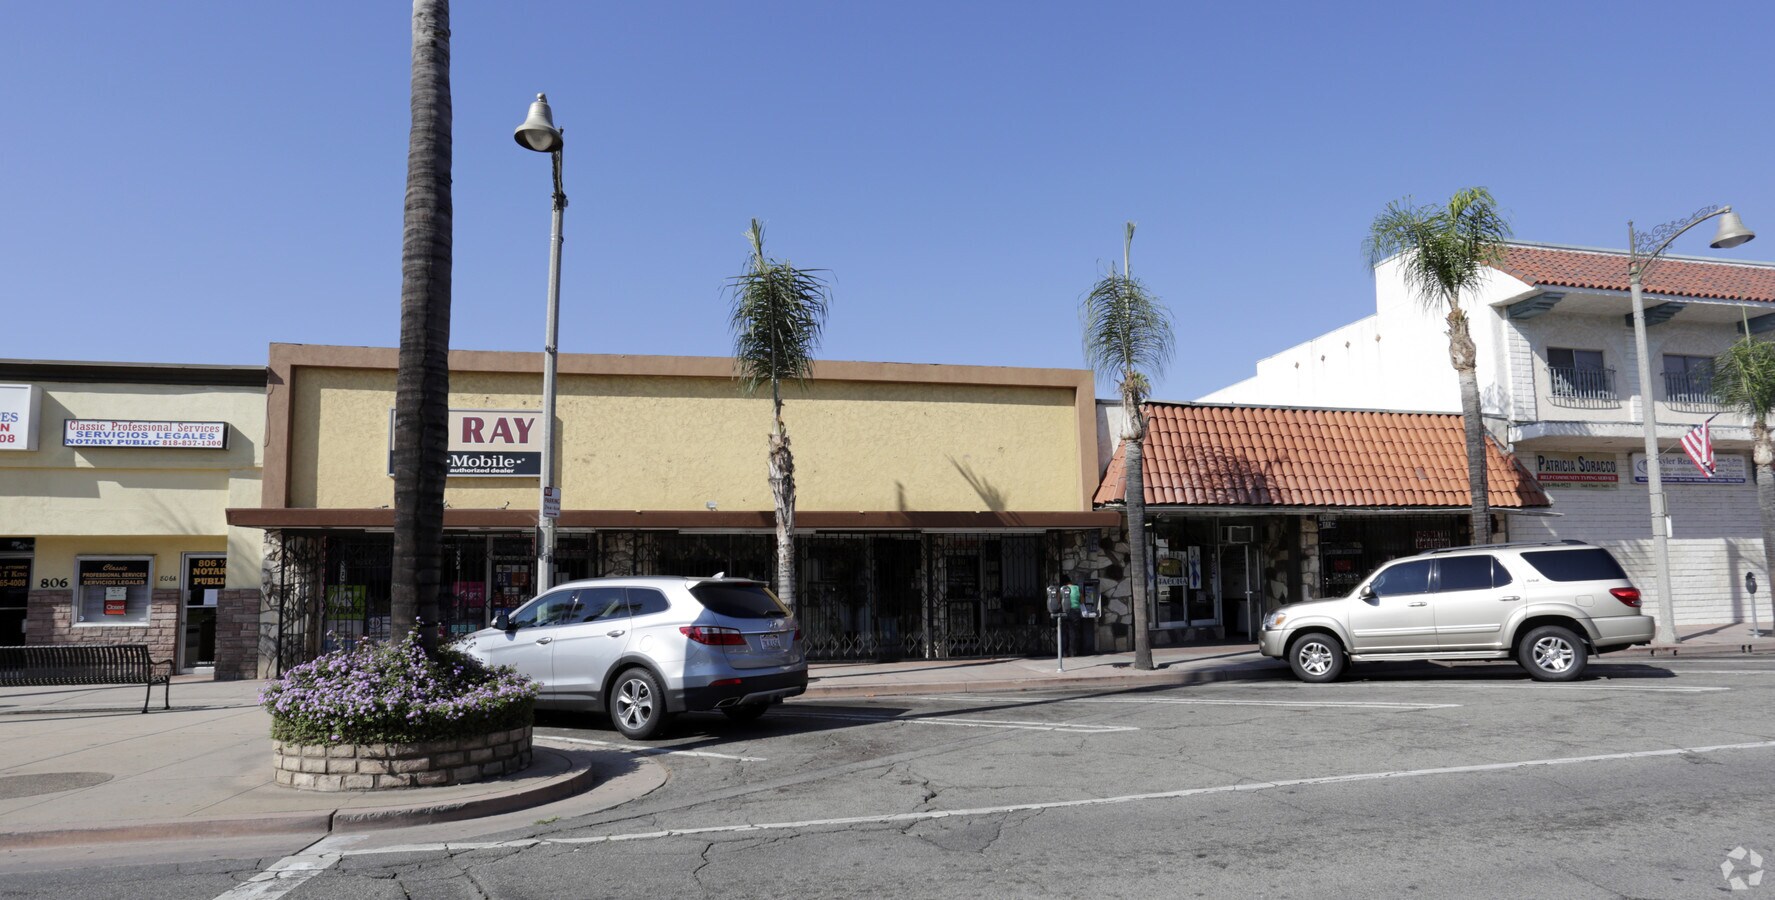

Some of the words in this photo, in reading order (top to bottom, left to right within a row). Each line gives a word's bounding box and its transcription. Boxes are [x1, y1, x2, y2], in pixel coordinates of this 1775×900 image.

[0, 412, 18, 422] ES
[69, 421, 105, 431] Classic
[111, 421, 172, 431] Professional
[178, 422, 220, 432] Services
[462, 416, 535, 443] RAY
[103, 563, 127, 571] Classic
[193, 567, 226, 575] NOTAR
[40, 578, 68, 588] 806
[193, 577, 225, 585] PUBLI
